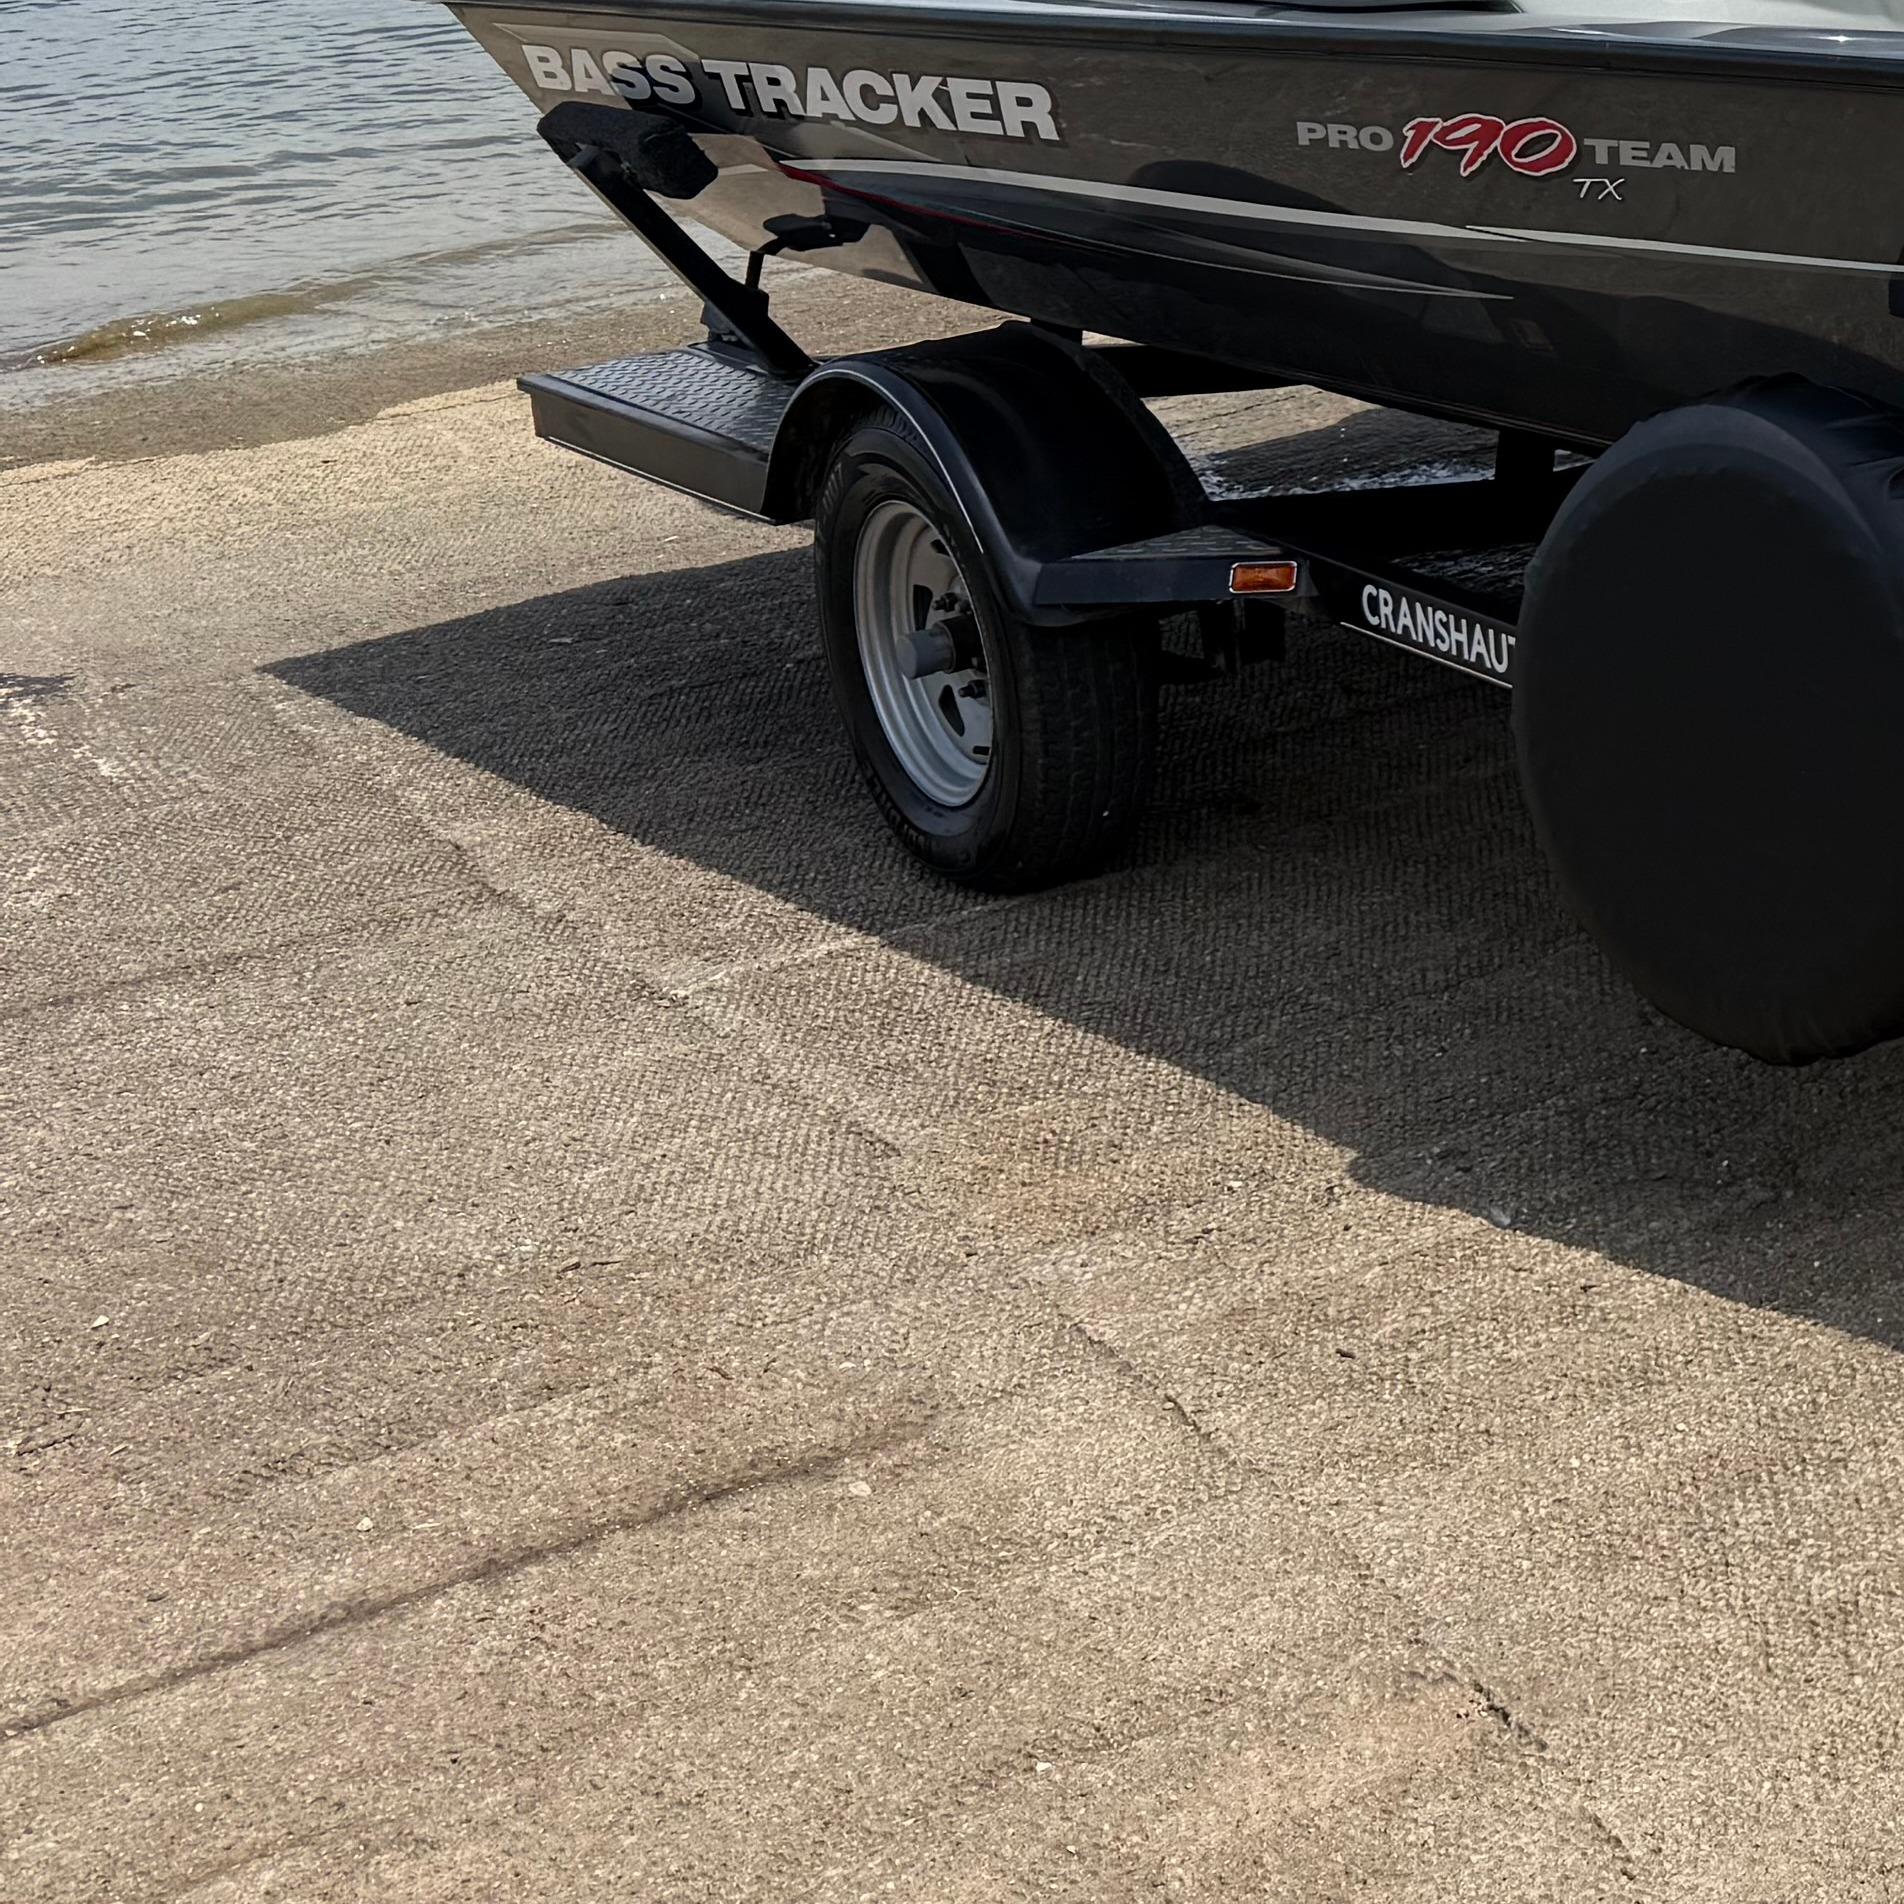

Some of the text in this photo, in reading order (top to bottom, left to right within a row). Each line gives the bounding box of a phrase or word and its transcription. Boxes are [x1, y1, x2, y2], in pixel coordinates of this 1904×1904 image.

[522, 44, 1060, 142] BASS TRACKER
[1296, 114, 1736, 176] PRO 190 TEAM
[1572, 178, 1625, 201] TX
[1362, 584, 1516, 673] CRANSHAU
